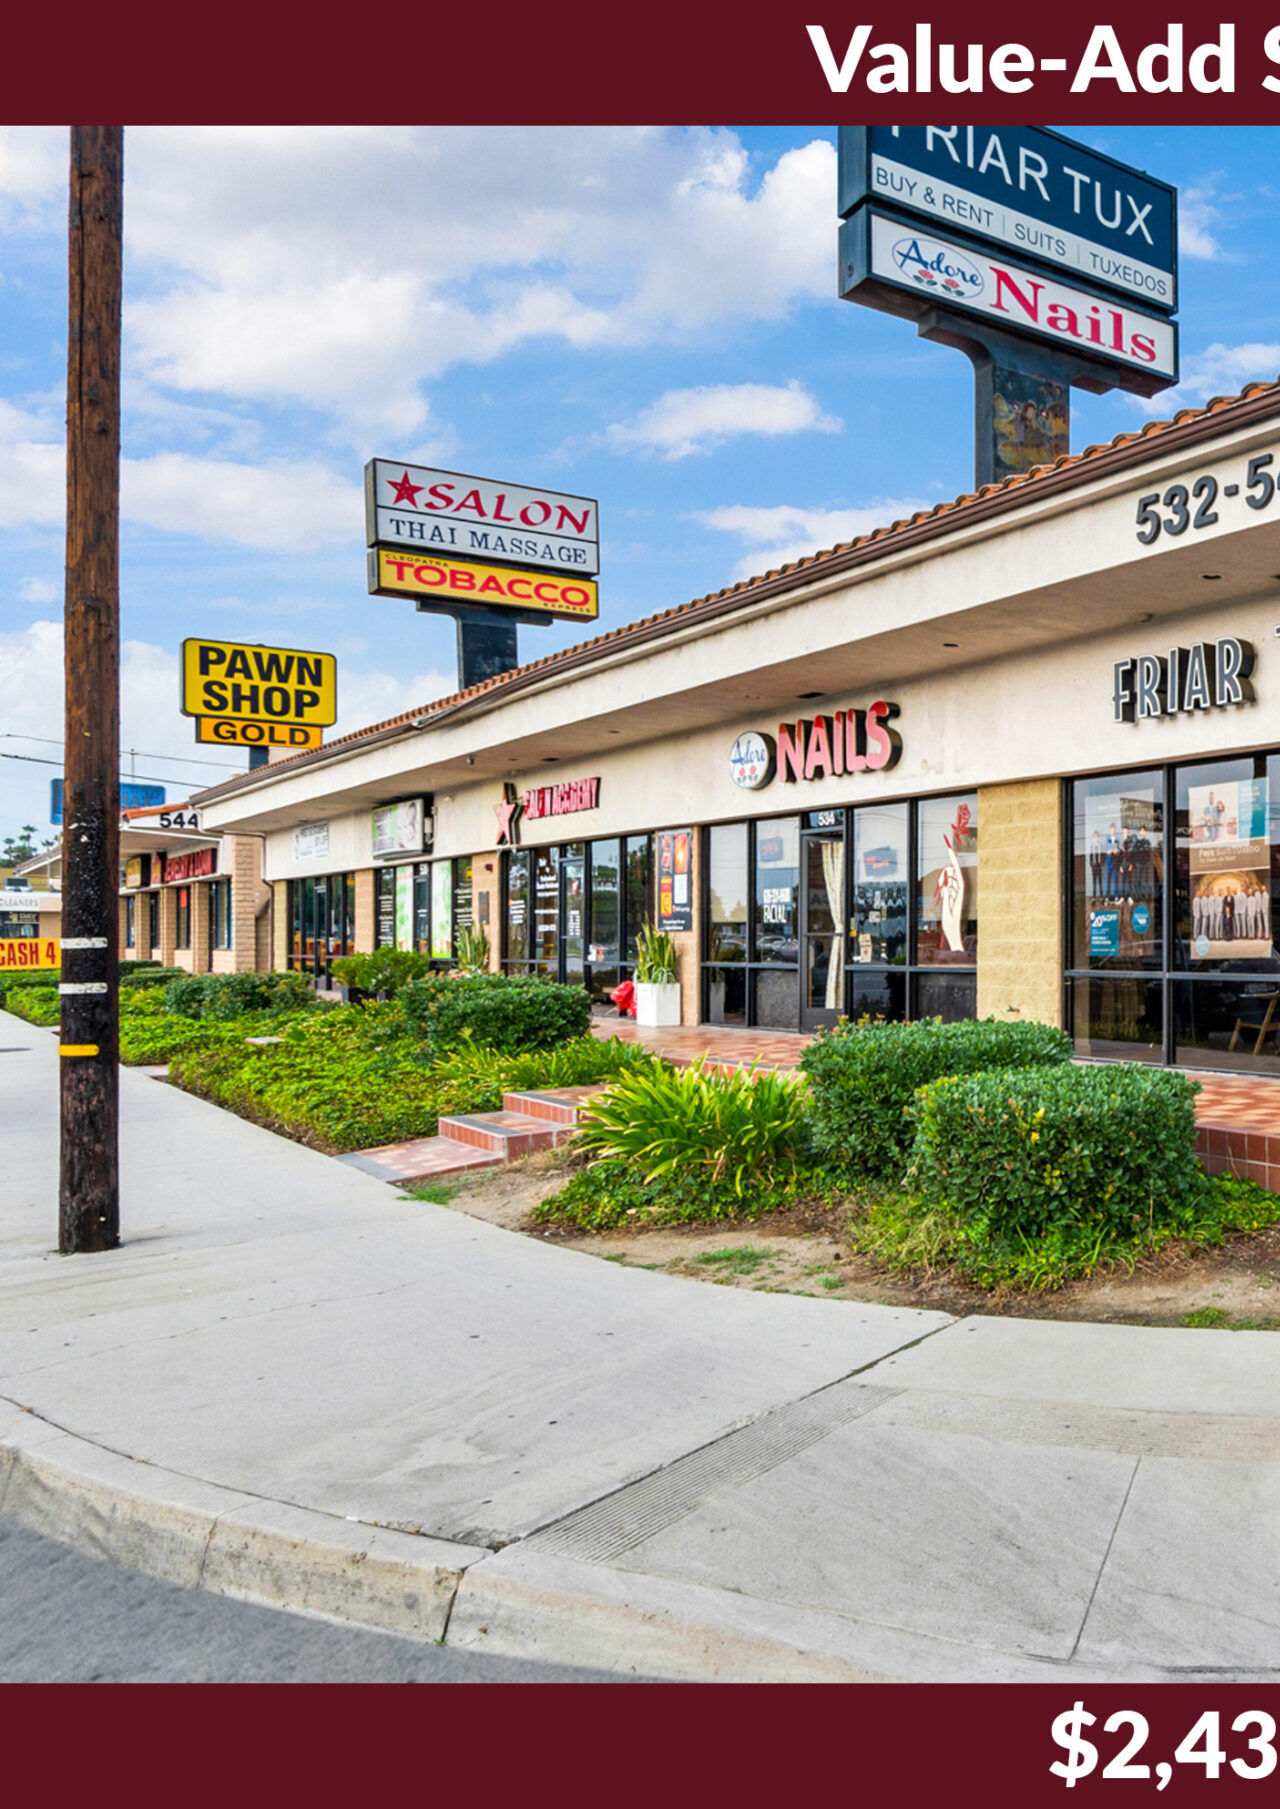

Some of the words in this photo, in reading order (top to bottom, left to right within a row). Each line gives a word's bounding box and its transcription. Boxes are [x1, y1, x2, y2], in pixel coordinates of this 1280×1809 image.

[1063, 166, 1154, 245] TUX
[876, 167, 918, 197] BUY
[923, 186, 936, 206] &
[942, 193, 994, 228] RENT
[1014, 223, 1066, 256] SUITS
[1089, 252, 1167, 296] TUXEDOS
[896, 240, 982, 287] Adore
[989, 266, 1156, 363] Nails
[424, 483, 590, 534] SALON
[385, 553, 449, 567] CLEOPATRA
[390, 518, 458, 545] THAI
[469, 530, 588, 564] MASSAGE
[385, 559, 590, 607] TOBACCO
[199, 645, 322, 687] PAWN
[1112, 636, 1250, 724] FRIAR
[202, 680, 320, 719] SHOP
[213, 721, 310, 746] GOLD
[731, 739, 766, 777] Adore
[776, 701, 899, 783] NAILS
[160, 812, 198, 829] 544
[818, 812, 835, 826] 534
[46, 941, 56, 965] 4
